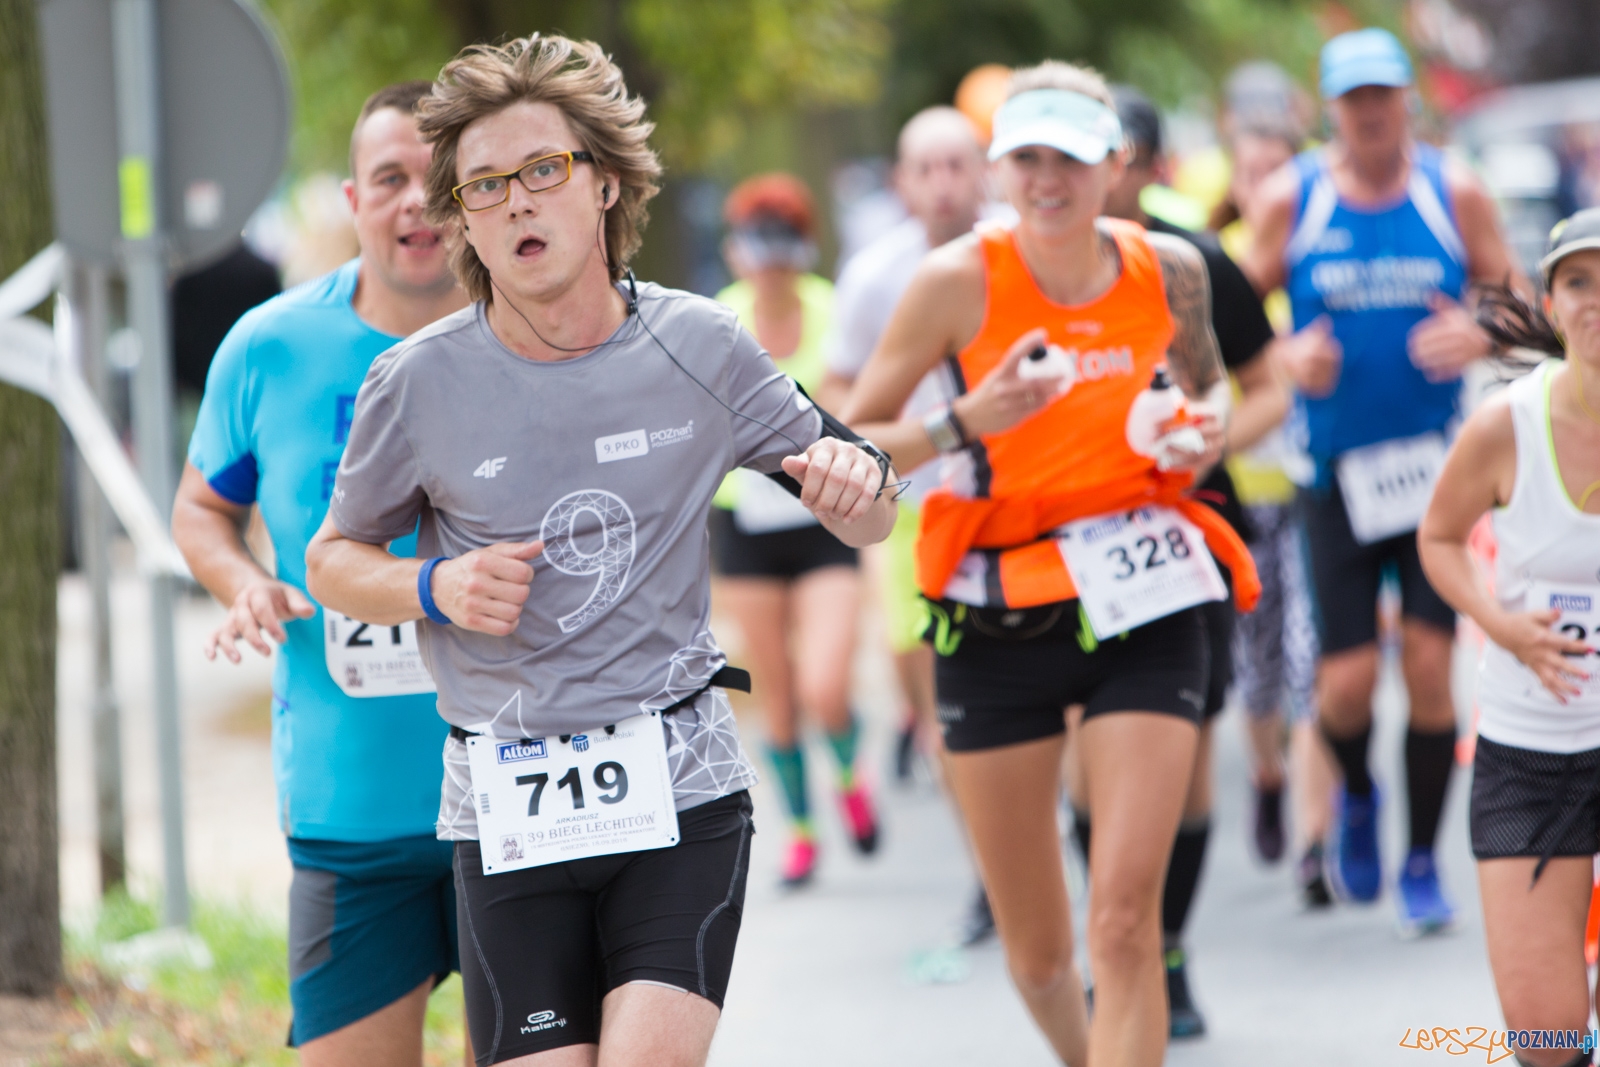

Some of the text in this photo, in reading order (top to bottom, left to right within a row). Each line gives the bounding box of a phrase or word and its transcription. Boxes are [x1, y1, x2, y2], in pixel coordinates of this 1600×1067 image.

[473, 456, 508, 478] 4F
[539, 489, 636, 634] 9
[1106, 526, 1191, 581] 328
[613, 730, 635, 741] Polski
[515, 761, 629, 817] 719
[555, 813, 600, 825] ARKADIUSZ
[527, 831, 544, 843] 39
[549, 824, 582, 840] BIEG
